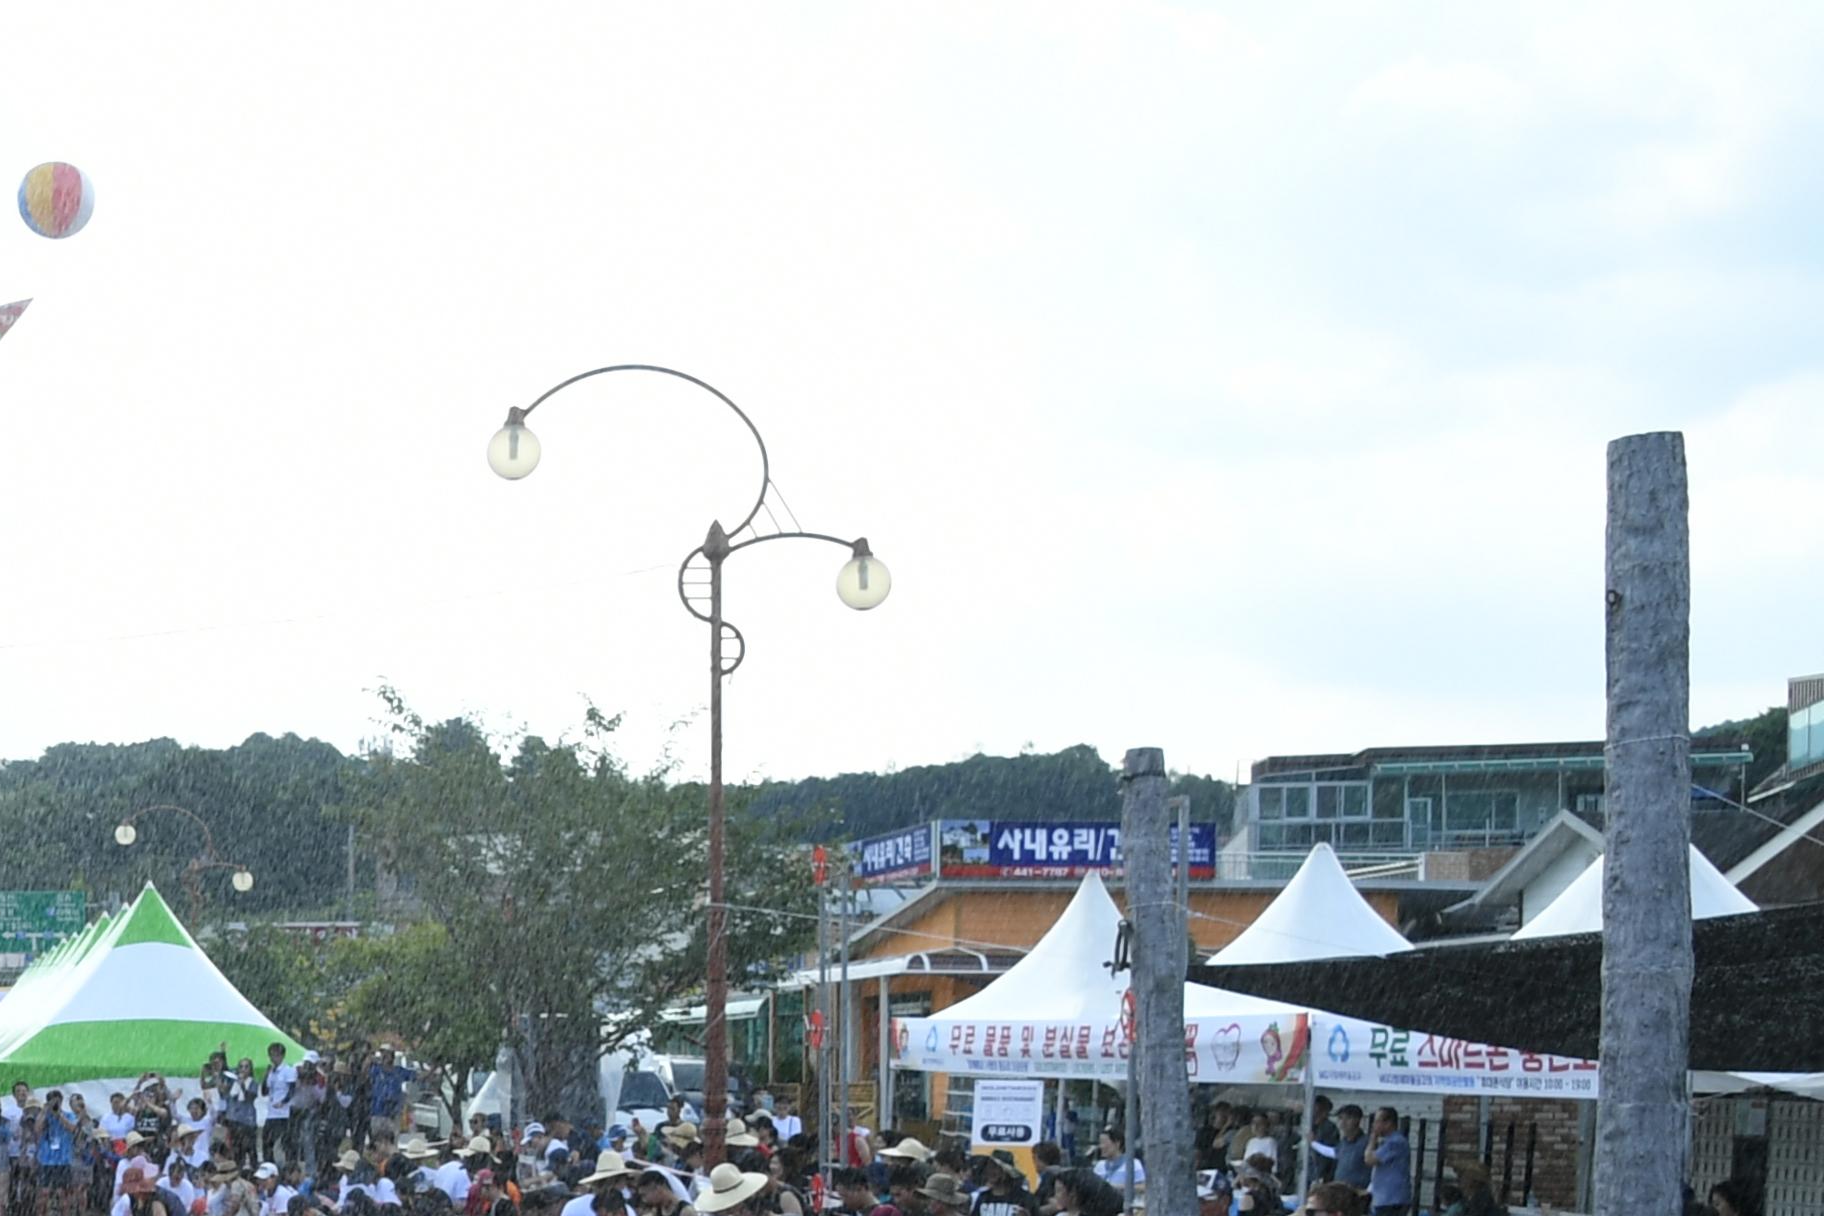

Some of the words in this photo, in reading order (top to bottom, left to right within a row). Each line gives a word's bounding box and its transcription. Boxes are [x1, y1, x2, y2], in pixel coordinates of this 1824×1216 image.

[949, 1025, 975, 1056] 무료
[983, 1025, 1011, 1057] 물품
[1042, 1025, 1091, 1059] 분실물
[1369, 1027, 1410, 1068] 무료
